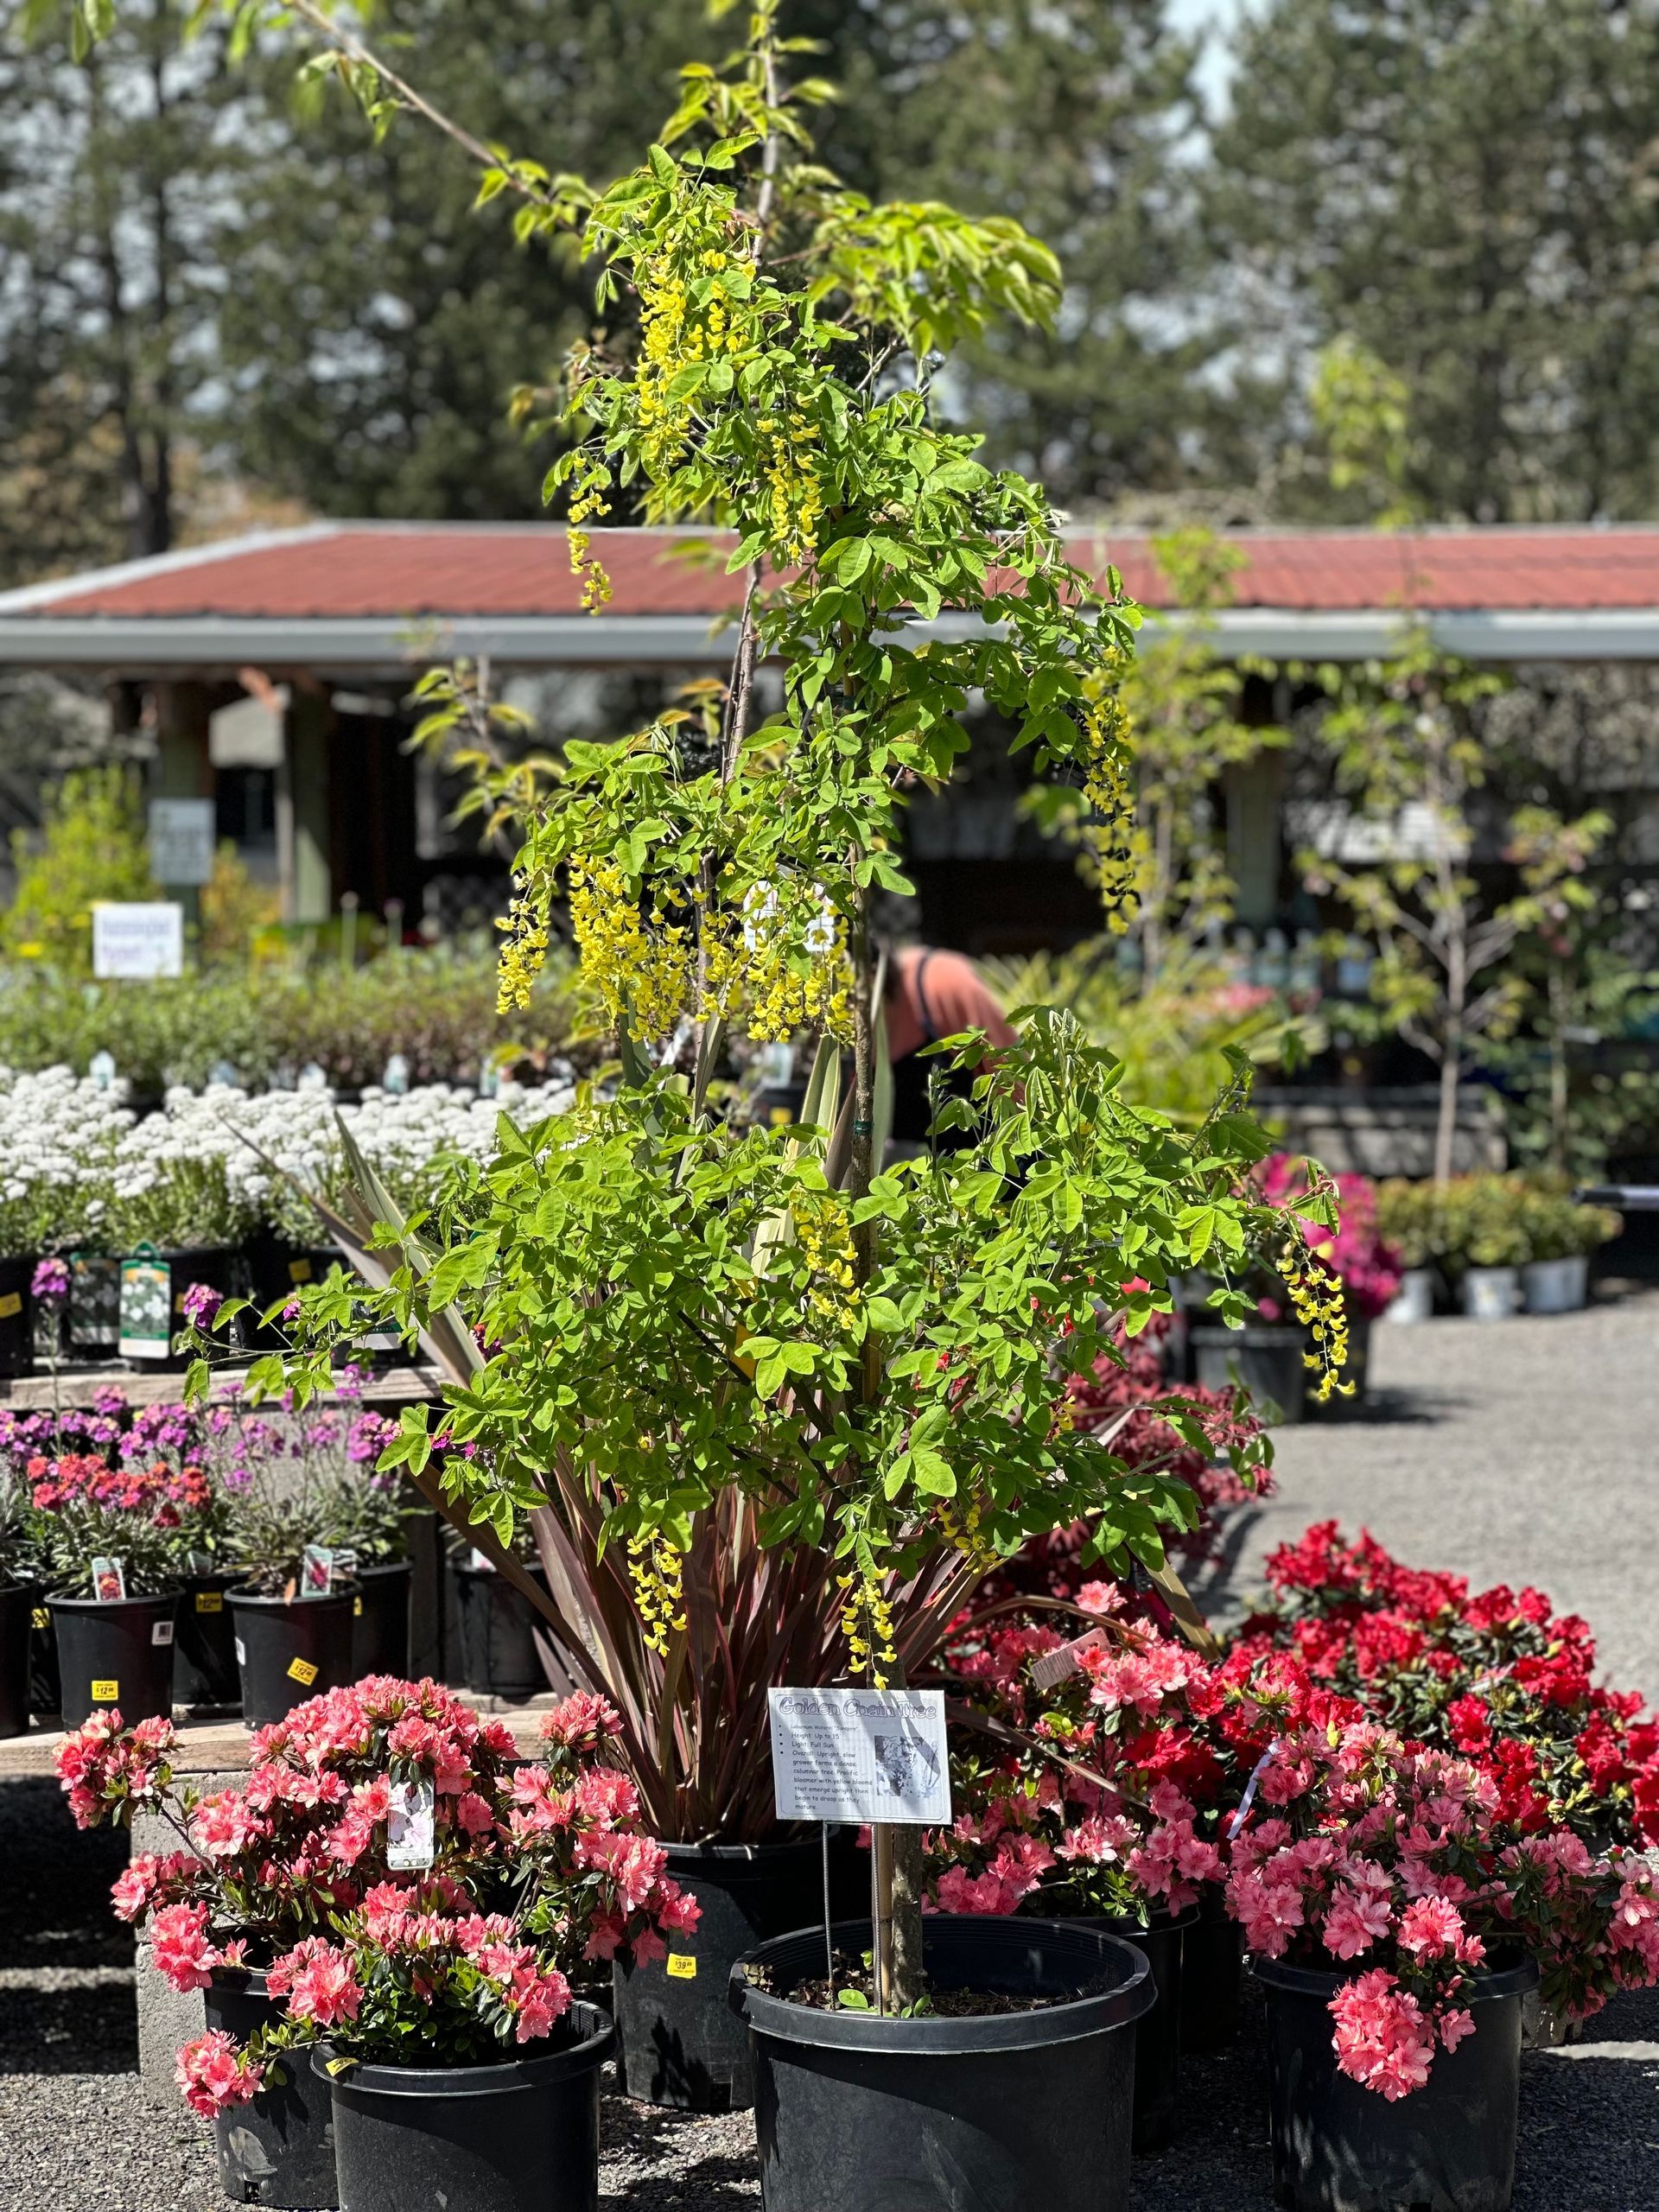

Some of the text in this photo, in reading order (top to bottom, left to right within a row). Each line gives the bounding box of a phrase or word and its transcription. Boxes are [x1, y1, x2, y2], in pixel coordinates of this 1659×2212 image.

[779, 1696, 937, 1719] Golden Chain Tree
